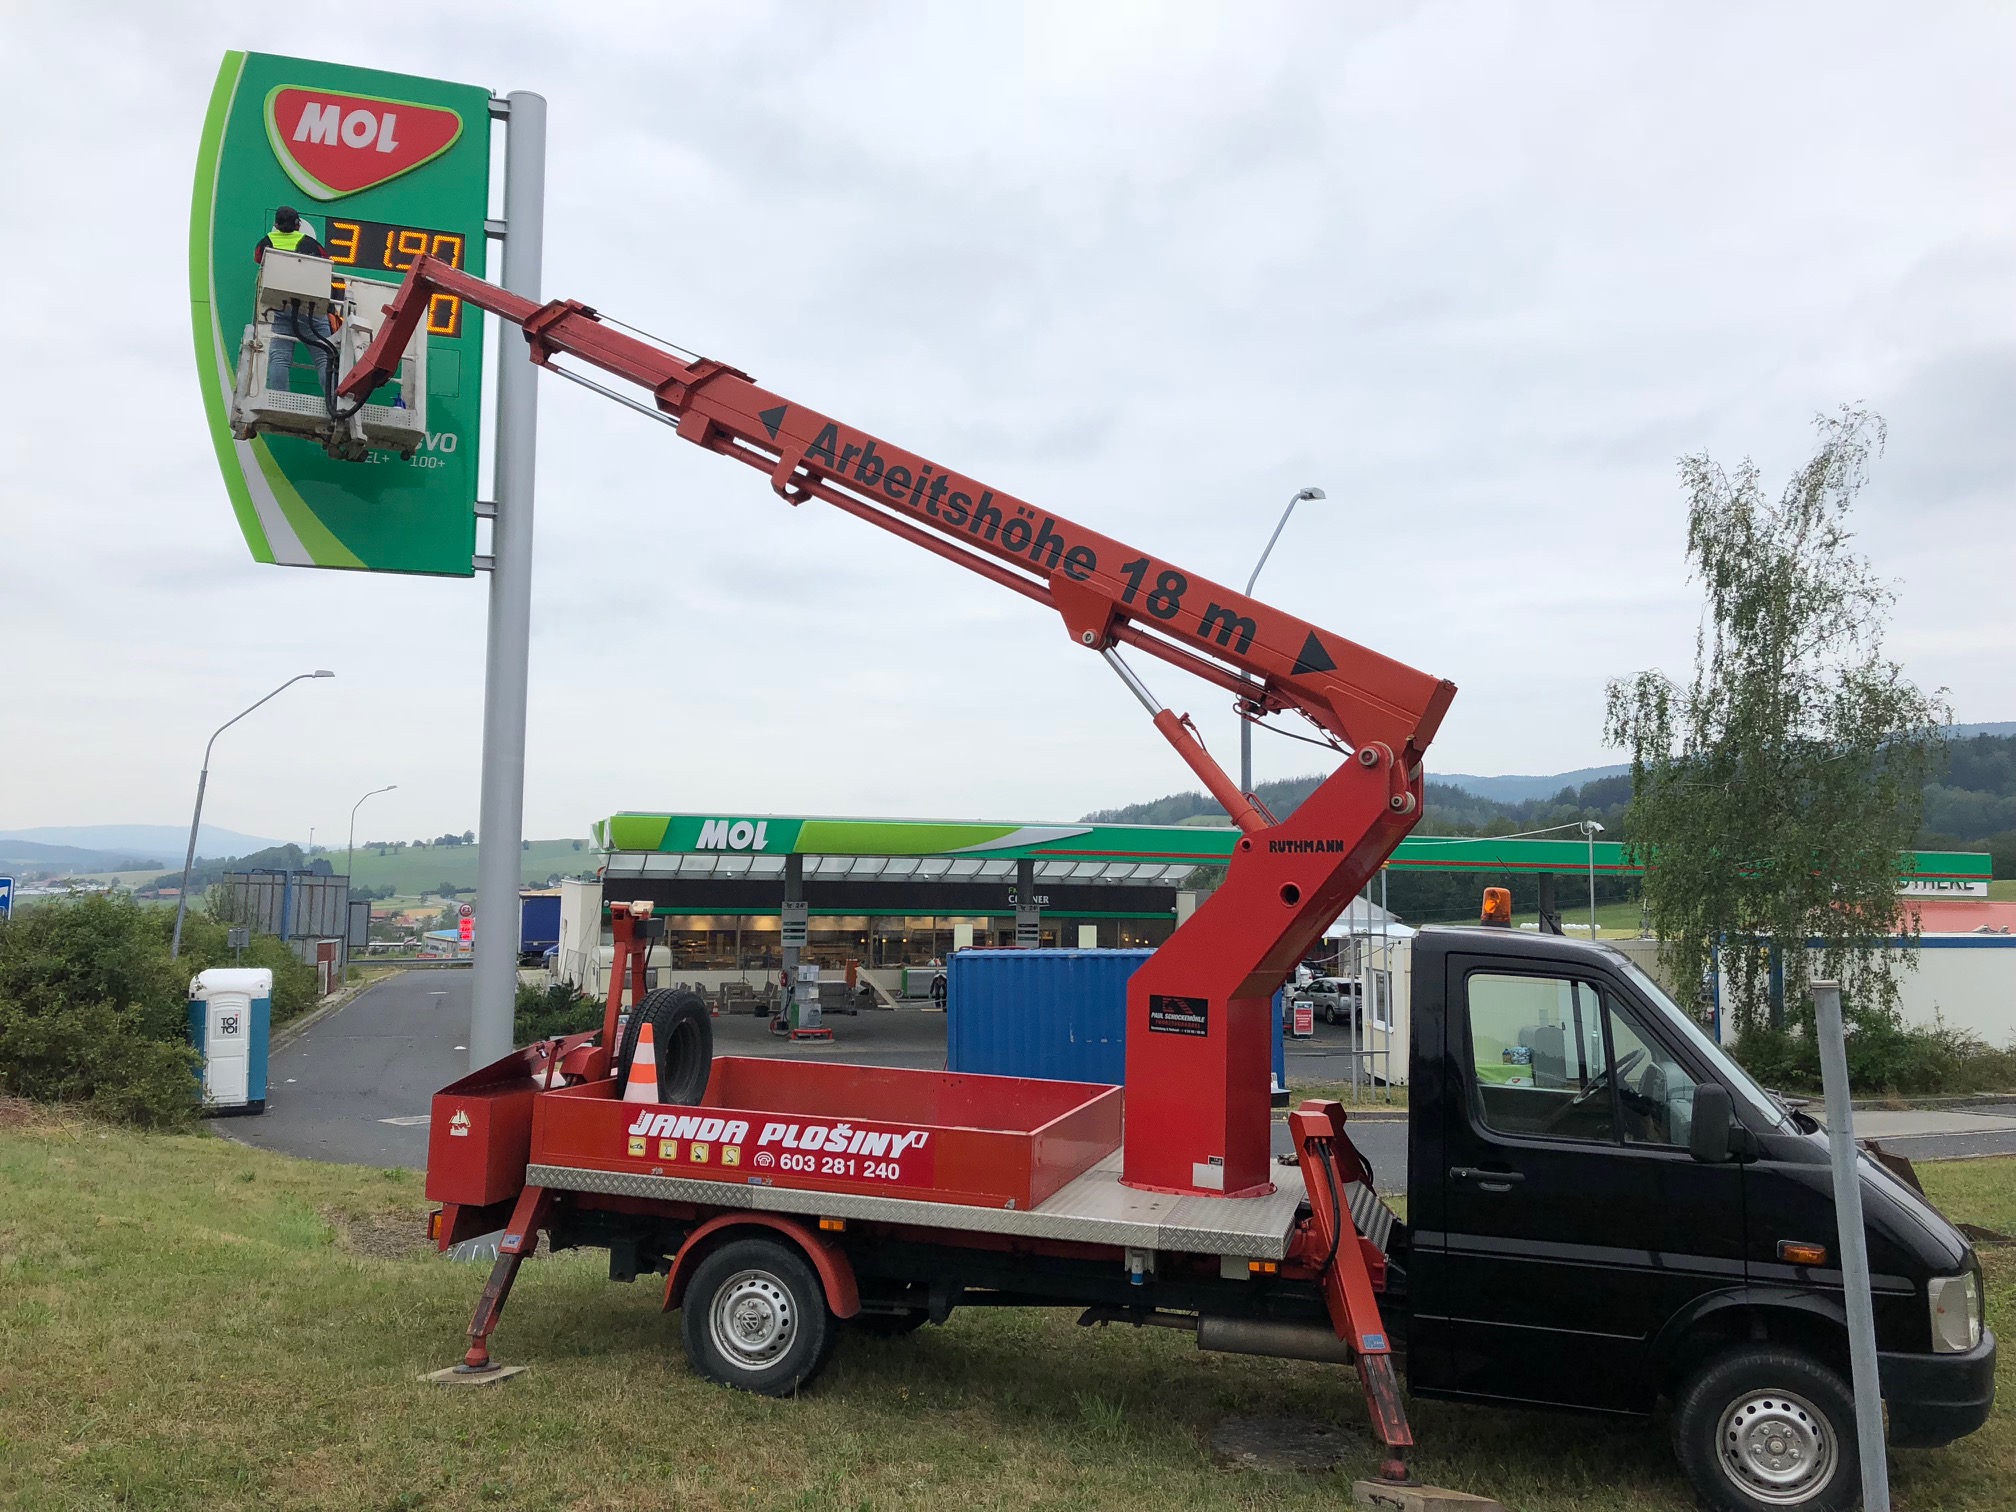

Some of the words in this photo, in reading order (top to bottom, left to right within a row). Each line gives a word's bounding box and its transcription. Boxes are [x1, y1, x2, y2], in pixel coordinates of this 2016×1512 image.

[293, 102, 399, 153] MOL
[410, 456, 445, 468] 100+
[804, 422, 1097, 581] Arbeitshöhe
[1120, 557, 1188, 620] 18
[1197, 602, 1257, 655] m
[695, 819, 769, 850] MOL
[1269, 840, 1344, 853] RUTHMANN
[1008, 894, 1049, 904] CNER
[221, 1025, 238, 1034] TOI
[628, 1113, 749, 1144] JANDA
[757, 1123, 926, 1158] PLOŠINY
[780, 1154, 815, 1172] 603
[821, 1157, 856, 1176] 281
[863, 1161, 899, 1180] 240
